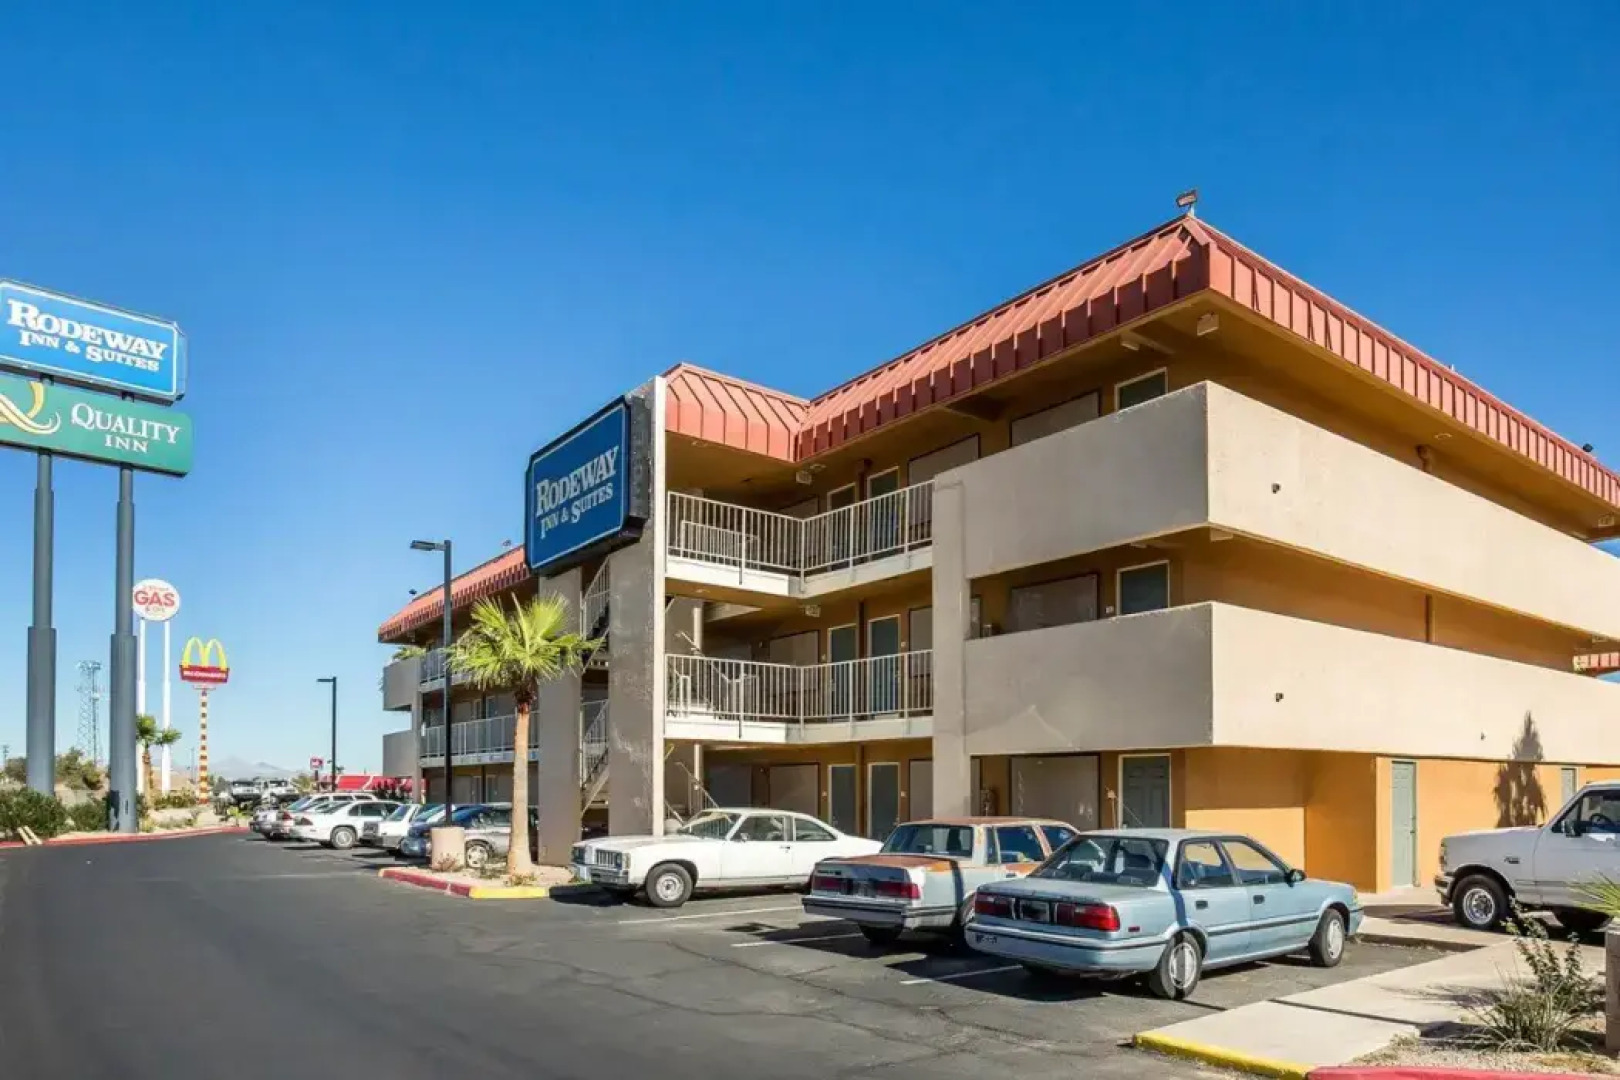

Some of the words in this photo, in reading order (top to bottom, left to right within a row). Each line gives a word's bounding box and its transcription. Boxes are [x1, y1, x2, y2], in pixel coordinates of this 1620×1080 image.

[7, 299, 169, 360] RODEWAY
[19, 329, 60, 348] INN
[64, 340, 81, 354] &
[85, 345, 160, 372] SUITES
[71, 403, 181, 444] QUALITY
[104, 434, 149, 453] INN
[536, 445, 620, 517] RODEWAY
[540, 511, 560, 540] INN
[561, 509, 569, 523] &
[571, 482, 614, 524] SUITES
[134, 590, 175, 607] GAS
